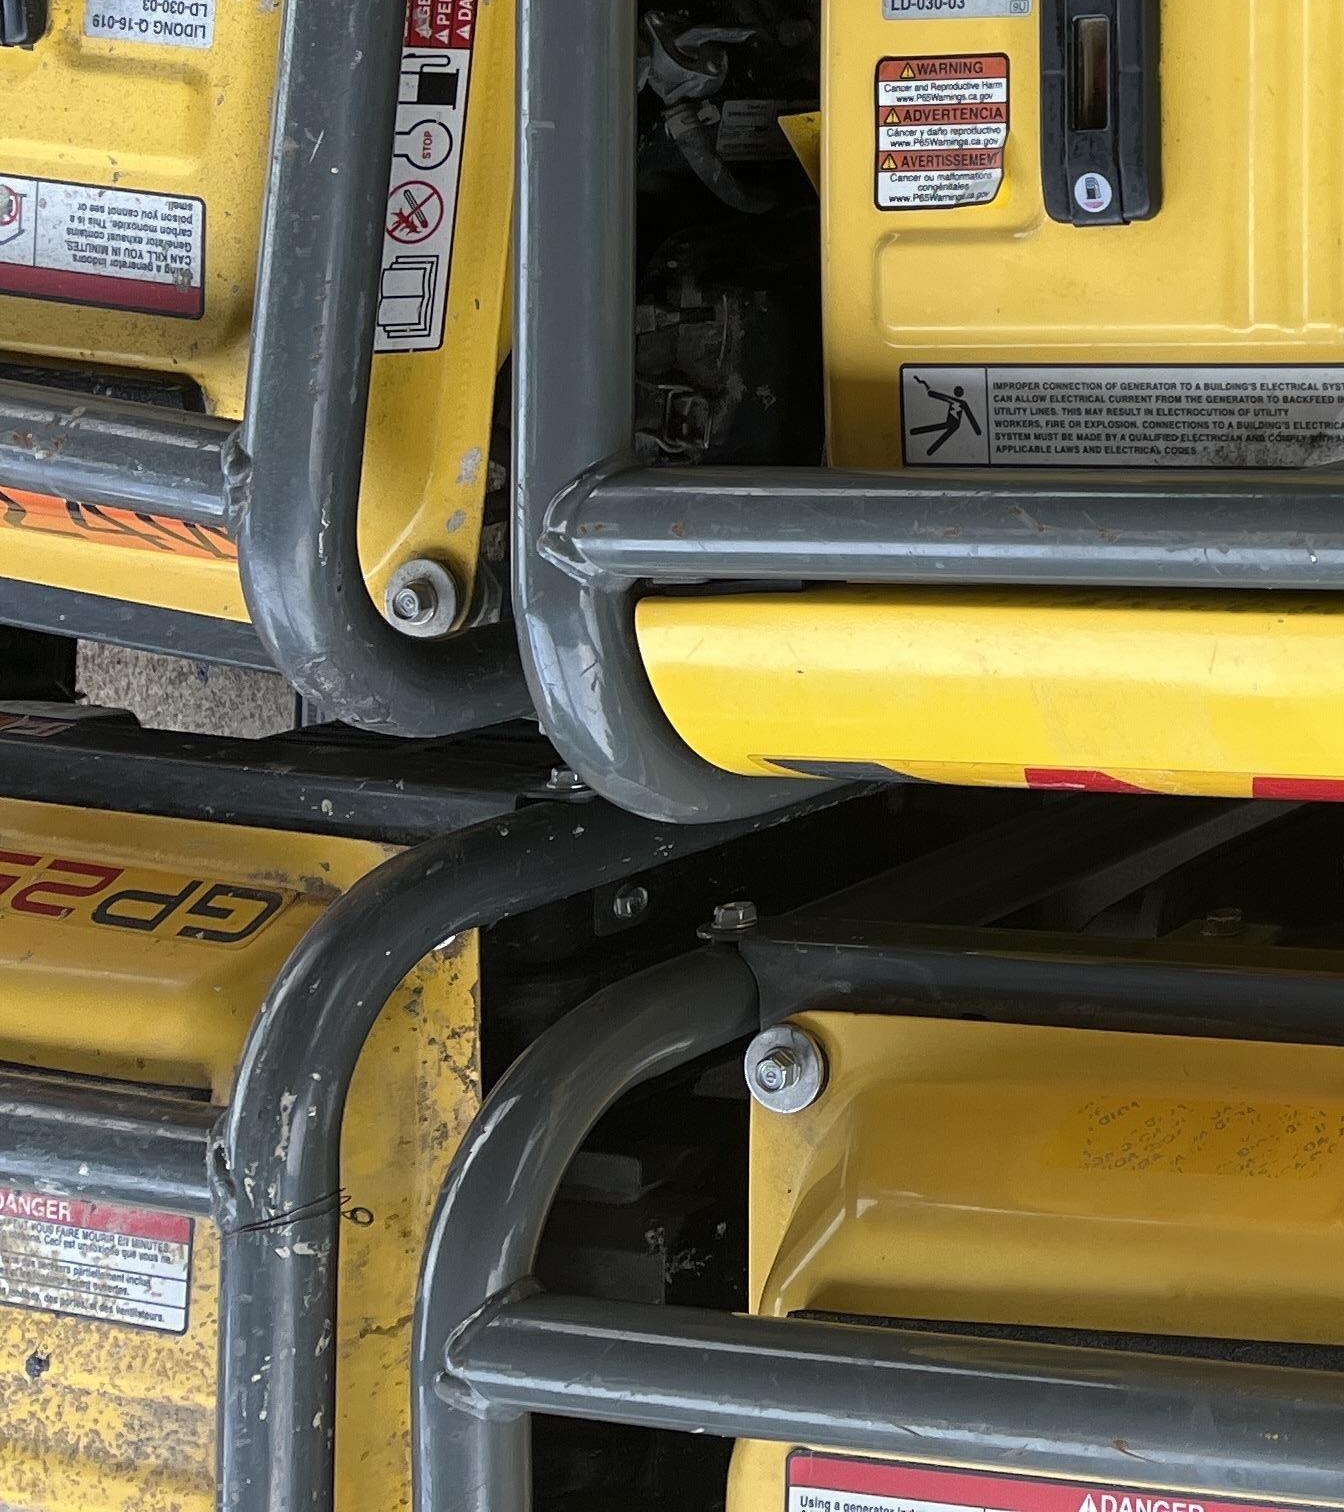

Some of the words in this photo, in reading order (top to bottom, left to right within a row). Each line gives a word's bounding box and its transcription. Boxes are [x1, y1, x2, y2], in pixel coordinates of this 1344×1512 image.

[93, 14, 149, 32] Q-16-019
[153, 20, 206, 39] LIDONG
[916, 61, 983, 74] WARNING
[884, 83, 912, 92] Cancer
[930, 82, 979, 92] Reproductive
[903, 107, 1003, 121] ADVERTENCIA
[422, 130, 433, 159] STOP
[992, 381, 1040, 391] IMPROPER
[1041, 381, 1103, 392] CONNECTION
[1104, 381, 1118, 391] OF
[1119, 381, 1177, 391] GENERATOR
[1178, 381, 1193, 391] TO
[1193, 382, 1201, 391] A
[1202, 381, 1257, 391] BUILDING'S
[1259, 381, 1319, 391] ELECTRICAL
